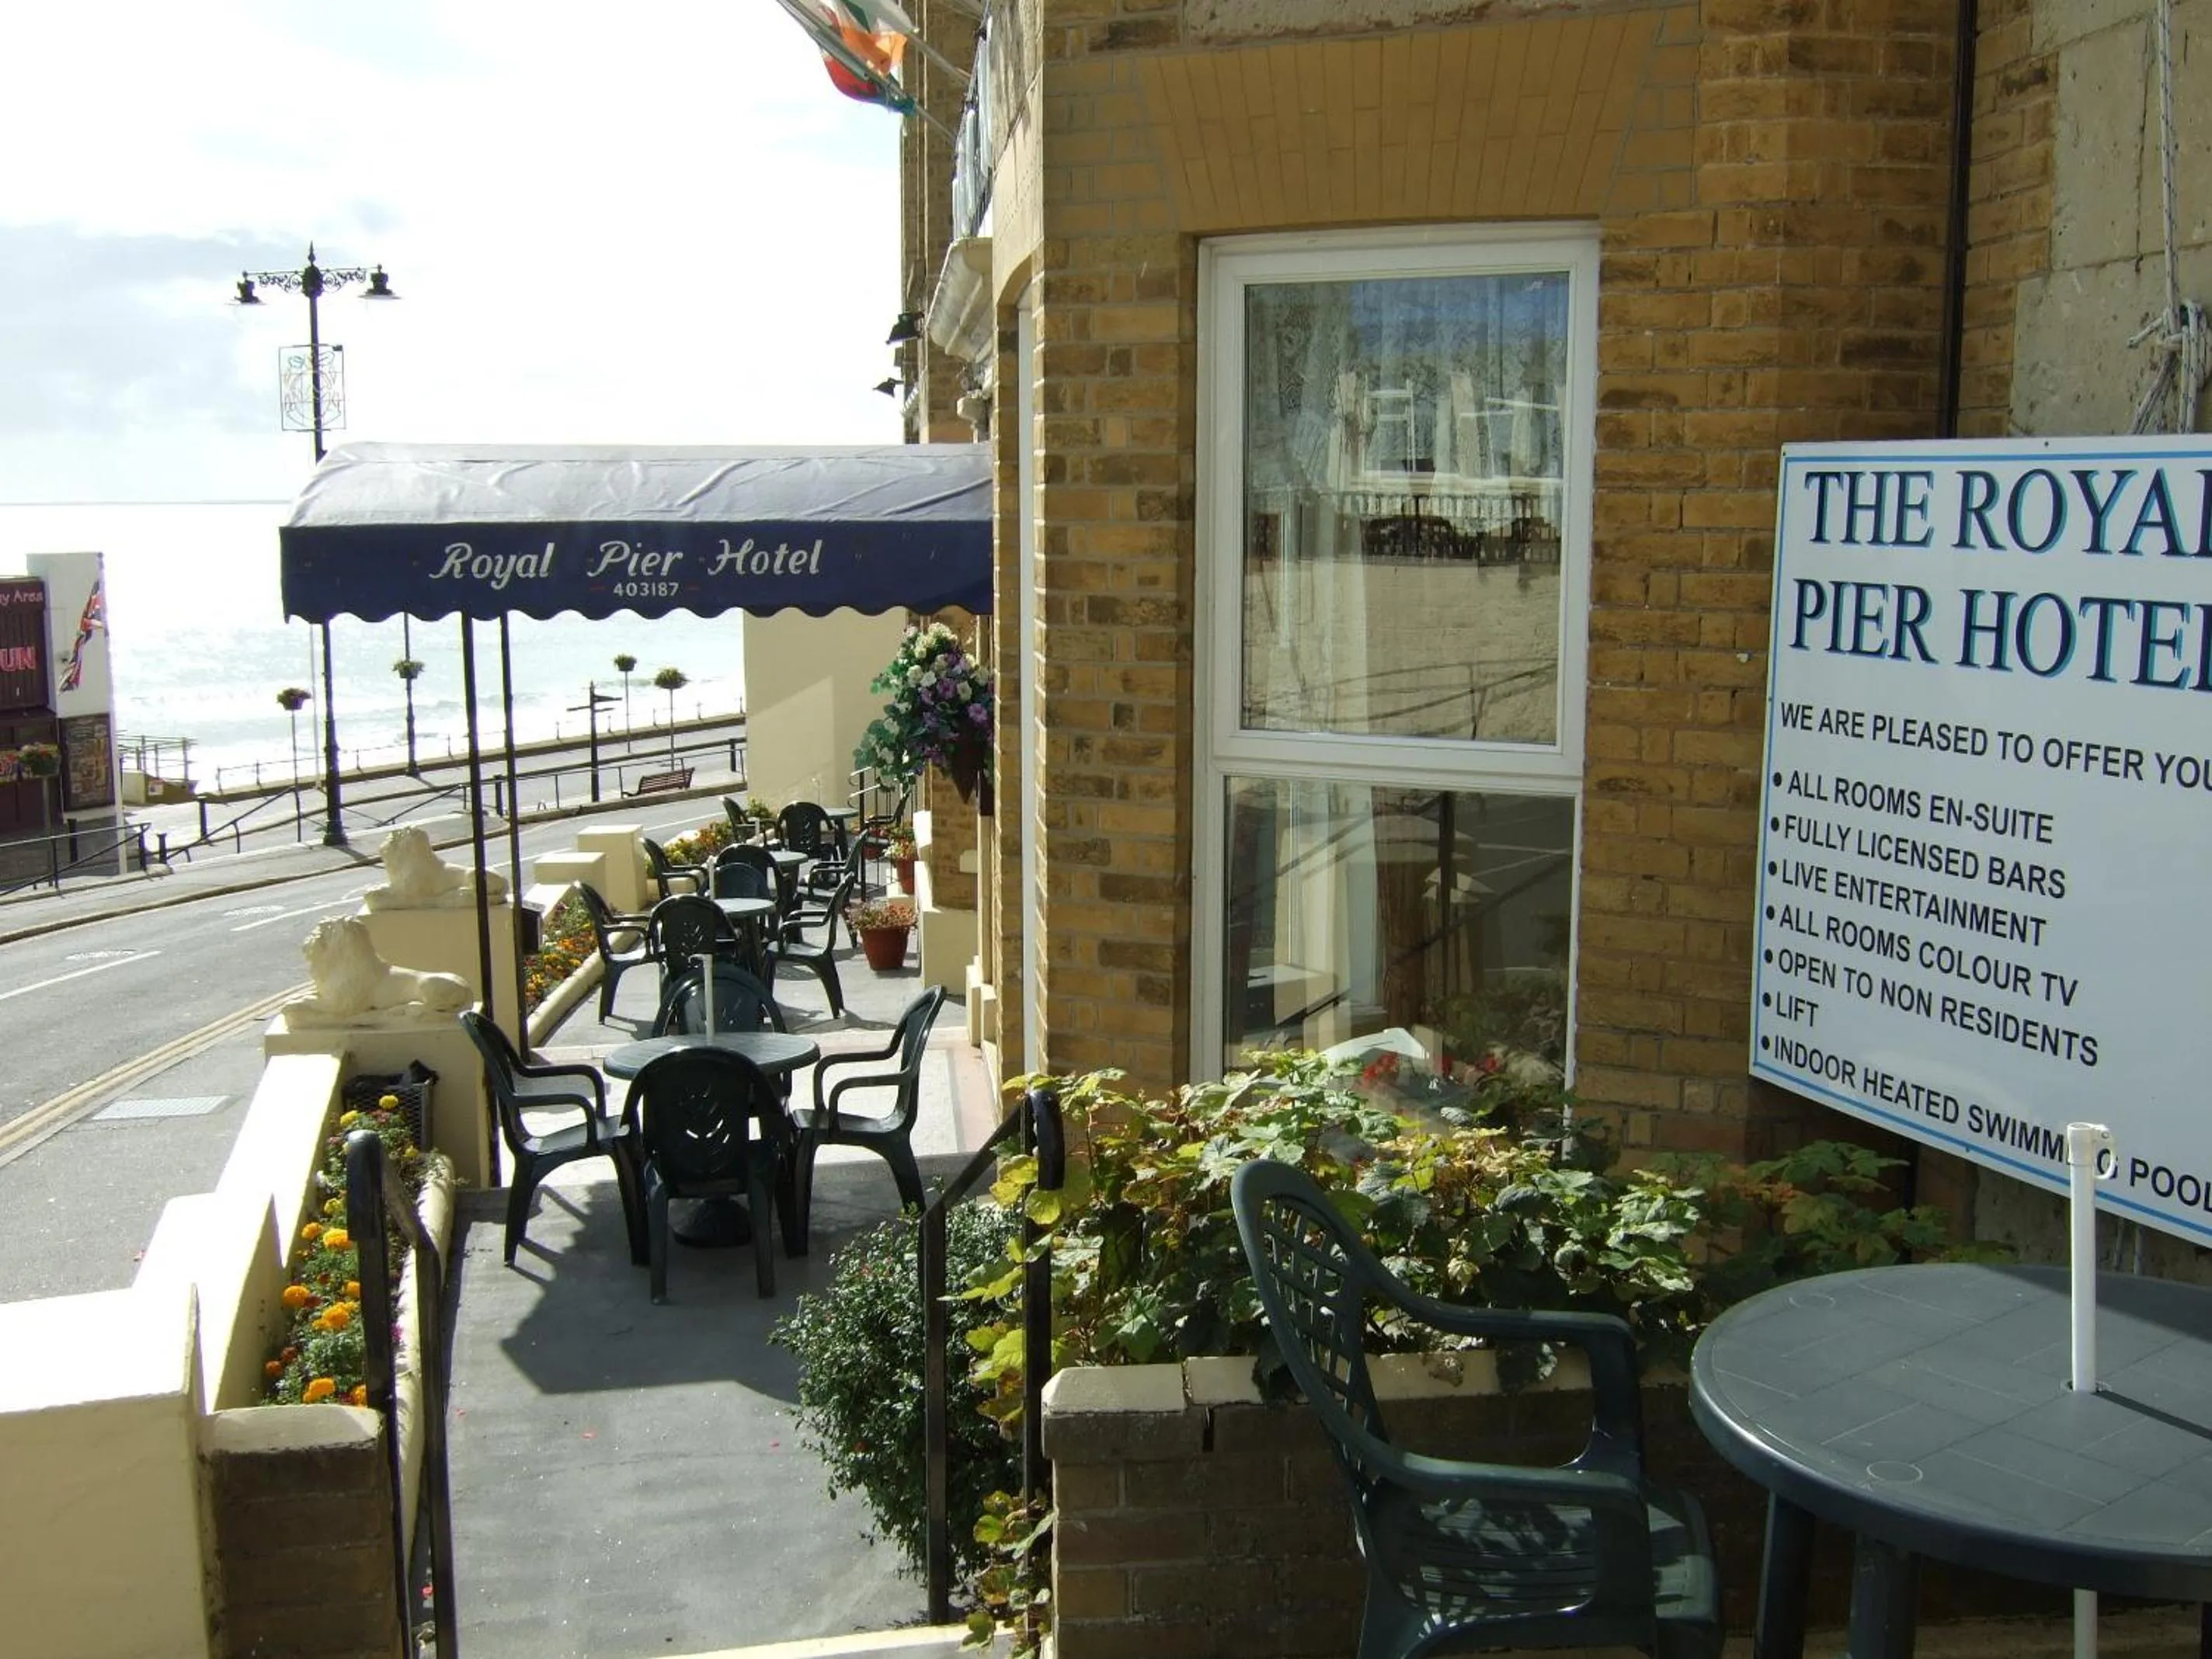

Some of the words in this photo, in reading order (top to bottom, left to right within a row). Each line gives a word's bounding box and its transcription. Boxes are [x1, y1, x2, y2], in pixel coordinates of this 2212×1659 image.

[1804, 470, 1934, 548] THE
[428, 541, 555, 590] Royal
[586, 540, 683, 577] Pier
[707, 537, 823, 576] Hotel
[613, 582, 680, 597] 403187
[1789, 577, 1939, 665] PIER
[1781, 701, 1814, 732] WE
[1818, 707, 1865, 739] ARE
[1872, 714, 1988, 756] PLEASED
[1998, 730, 2034, 763] TO
[2043, 738, 2144, 781] OFFER
[1788, 770, 1828, 802] ALL
[1834, 777, 1922, 819] ROOMS
[1929, 795, 2054, 845] EN-SUITE
[1784, 814, 1852, 852] FULLY
[1857, 829, 1980, 881] LICENSED
[1988, 856, 2067, 899] BARS
[1782, 859, 1828, 894] LIVE
[1835, 871, 2047, 948] ENTERTAINMENT
[1779, 904, 1820, 937] ALL
[1826, 915, 1911, 963] ROOMS
[1919, 941, 2032, 997] COLOUR
[2040, 971, 2079, 1007] TV
[1776, 991, 1819, 1028] LIFT
[1779, 948, 1837, 989] OPEN
[1843, 966, 1874, 1000] TO
[1880, 979, 1932, 1018] NON
[1941, 996, 2099, 1067] RESIDENTS
[1774, 1035, 1857, 1089] INDOOR
[1863, 1067, 1960, 1125] HEATED
[1967, 1104, 2119, 1181] SWIMMG
